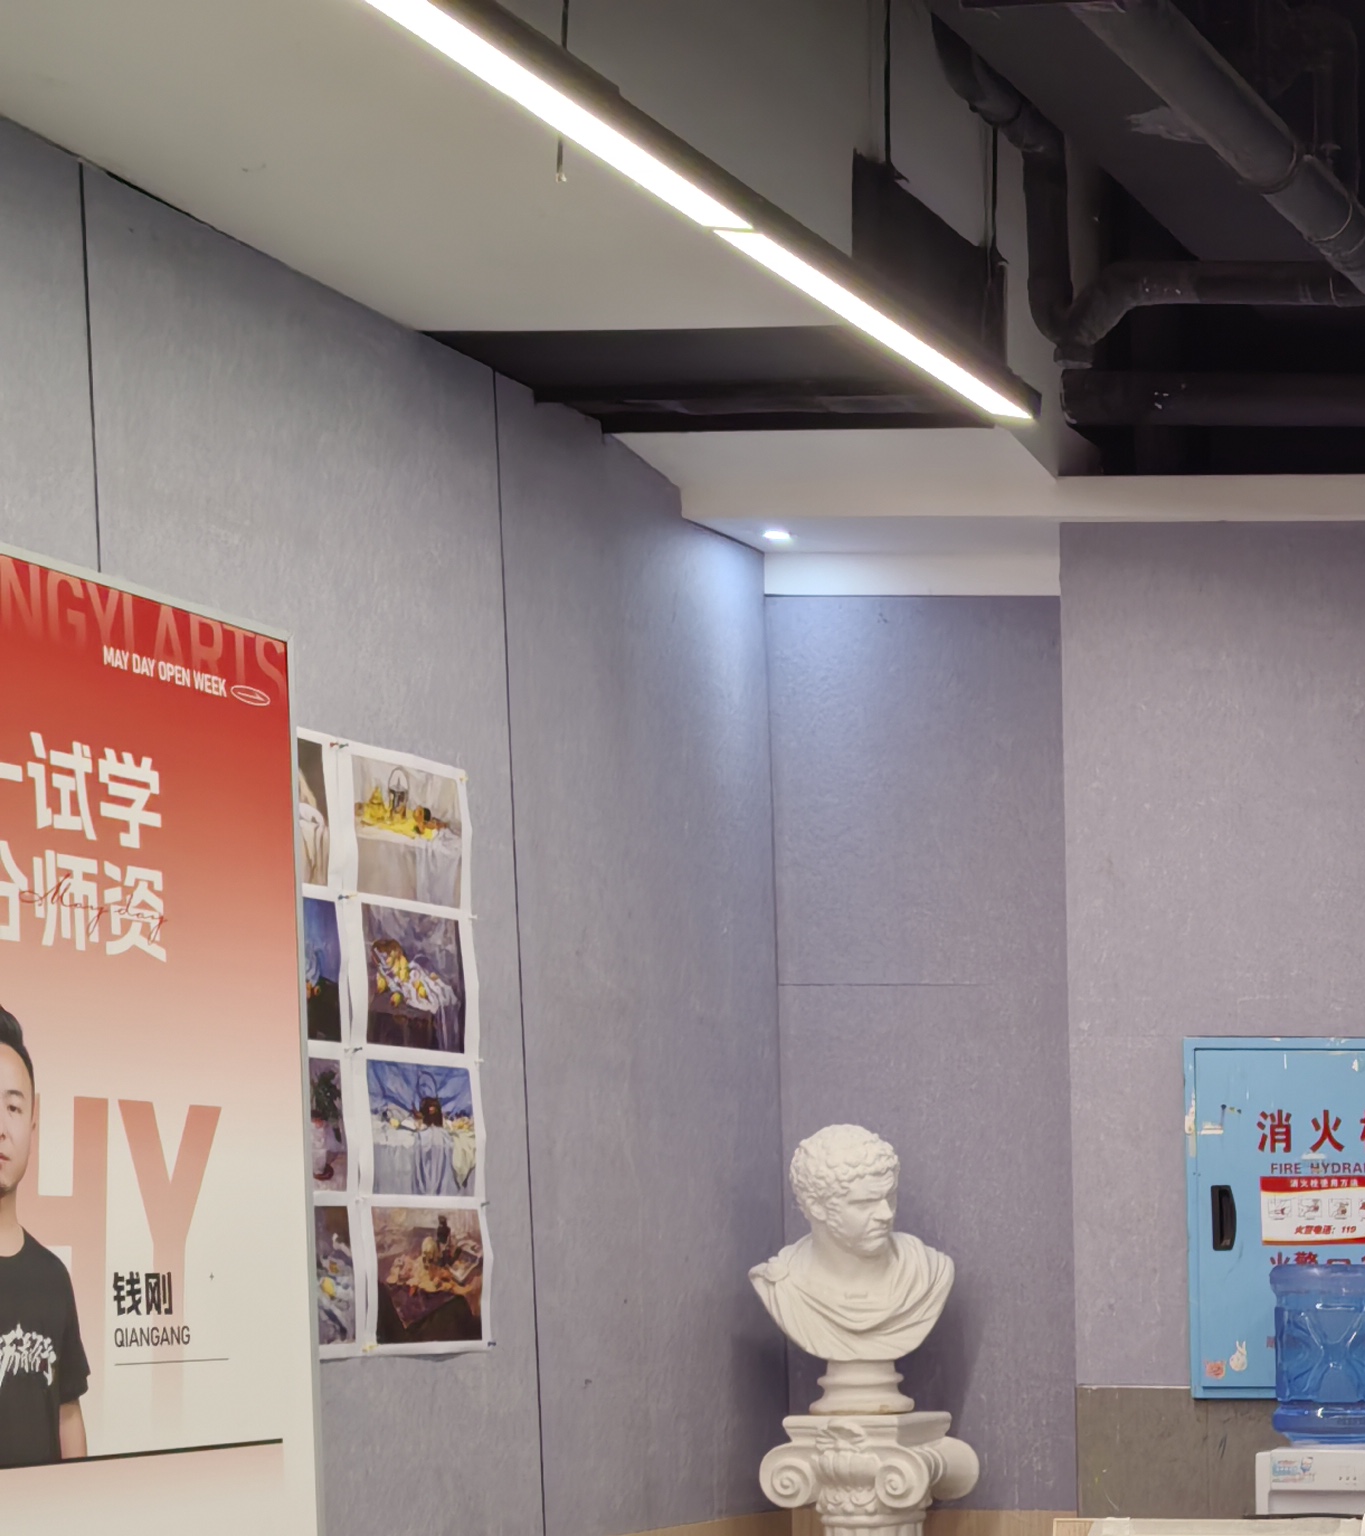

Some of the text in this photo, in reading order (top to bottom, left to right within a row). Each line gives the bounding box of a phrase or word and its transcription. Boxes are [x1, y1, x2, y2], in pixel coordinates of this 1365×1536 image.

[103, 645, 228, 698] MAY DAY OPEN WEEK
[1270, 1162, 1302, 1175] FIRE
[1290, 1178, 1359, 1188] 消火栓使用方法
[1341, 1225, 1357, 1234] 119
[112, 1271, 174, 1317] 钱刚
[114, 1324, 192, 1350] QIANGANG
